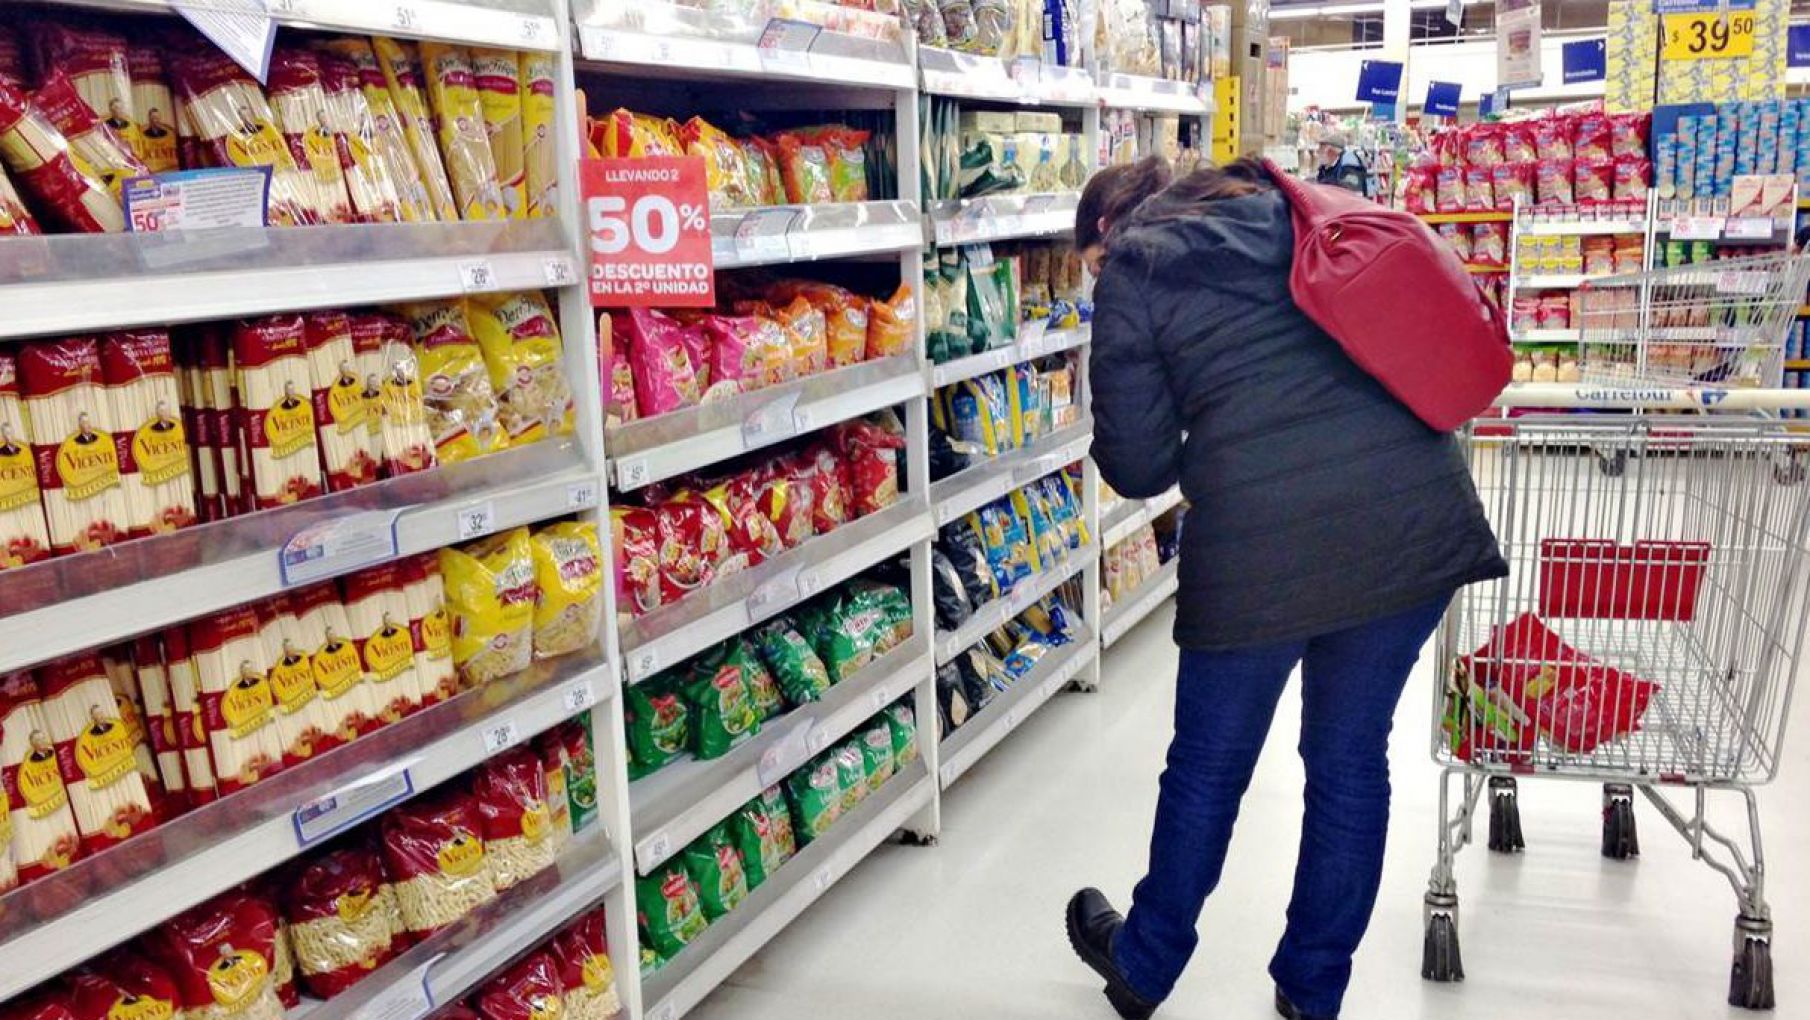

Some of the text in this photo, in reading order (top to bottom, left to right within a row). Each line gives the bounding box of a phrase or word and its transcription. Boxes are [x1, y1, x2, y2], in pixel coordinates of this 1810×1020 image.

[1688, 19, 1730, 53] 39
[1733, 17, 1753, 35] 50
[605, 168, 680, 183] LLEVANDO 2
[587, 194, 706, 255] 50%
[592, 262, 709, 281] DESCUENTO
[591, 281, 612, 294] EN
[614, 281, 634, 294] LA
[652, 280, 710, 295] UNIDAD
